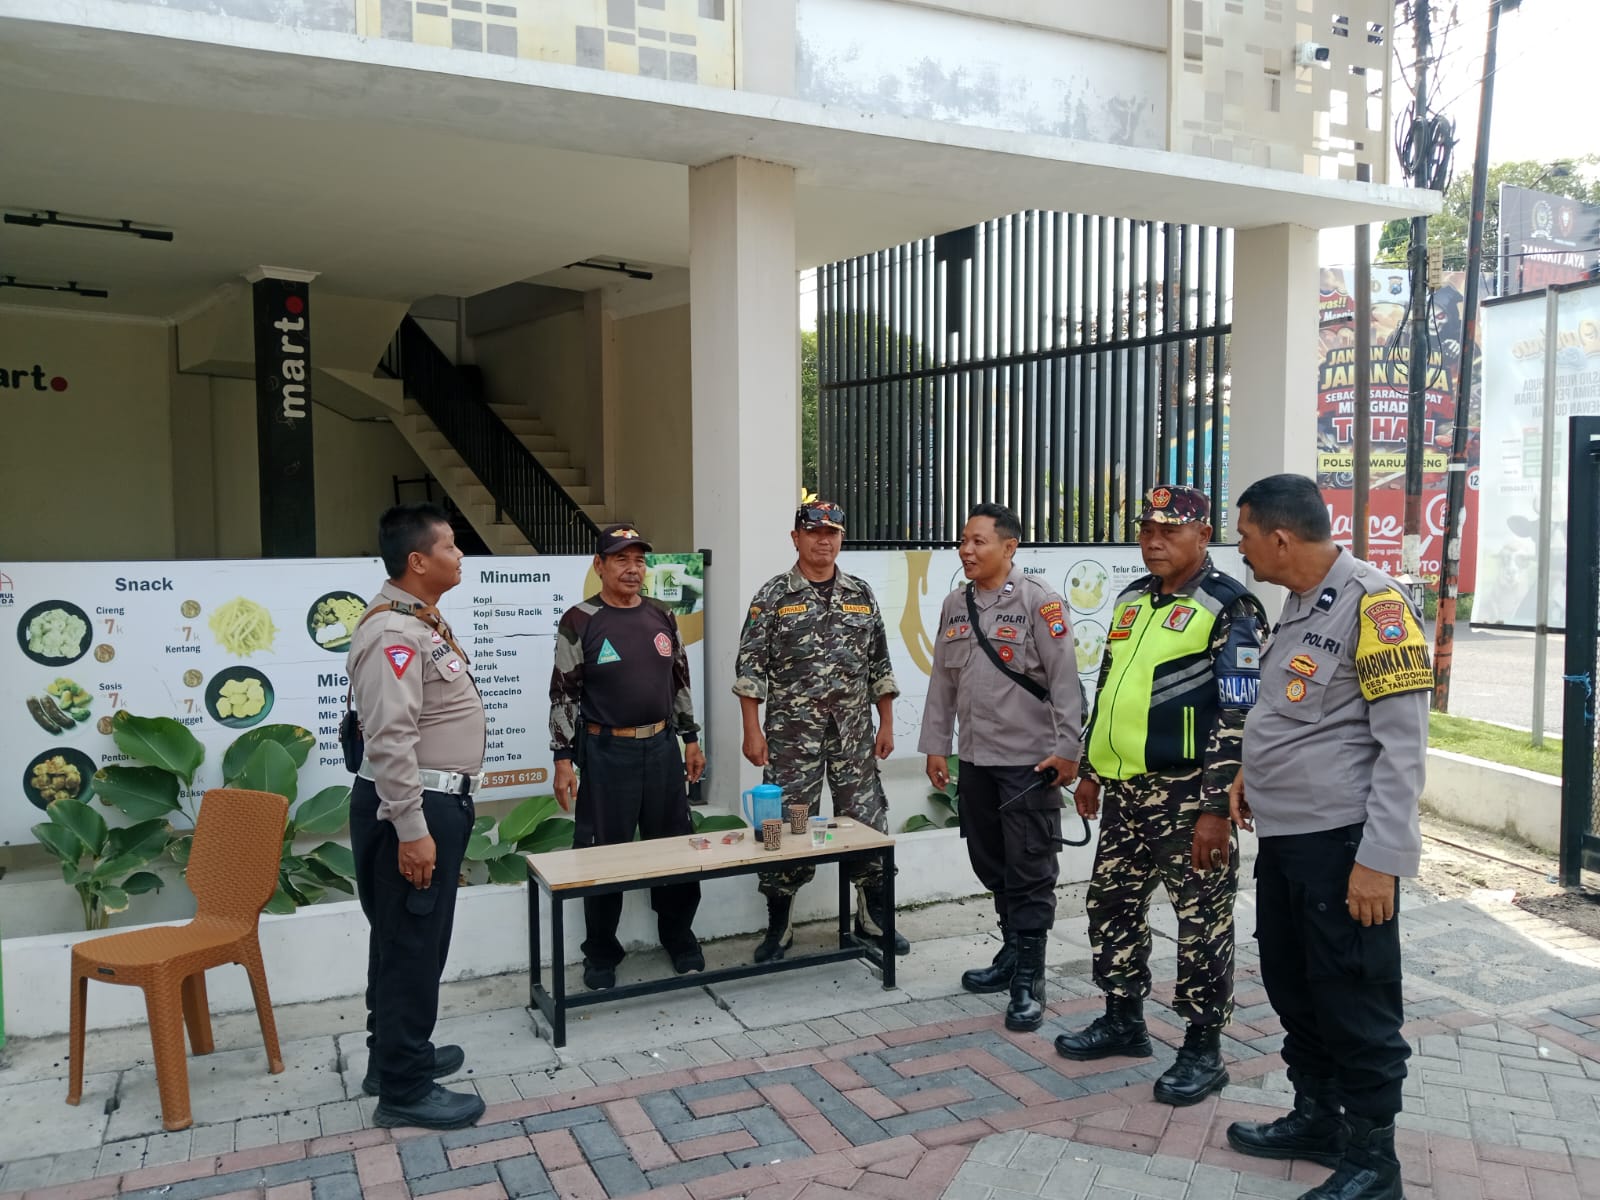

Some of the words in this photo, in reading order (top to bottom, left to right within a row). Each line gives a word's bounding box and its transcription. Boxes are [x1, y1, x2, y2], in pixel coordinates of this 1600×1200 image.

[1328, 347, 1383, 366] JANN
[1388, 347, 1442, 366] JADAN
[274, 317, 306, 418] mart
[1321, 363, 1388, 390] JAN
[1393, 363, 1448, 391] RYA
[1338, 401, 1428, 414] MGHAD
[1332, 416, 1435, 445] THA
[1323, 458, 1354, 467] POLS
[1369, 458, 1442, 467] WARUJENG
[1112, 565, 1129, 573] Telur
[480, 571, 551, 583] Minuman
[115, 577, 174, 591] Snack
[473, 596, 493, 604] Kopi
[96, 607, 125, 615] Cireng
[473, 610, 493, 618] Kopi
[518, 608, 543, 616] Racik
[995, 614, 1026, 624] POLRI
[1302, 632, 1341, 654] POLRI
[165, 645, 201, 653] Kentang
[474, 663, 498, 671] Jeruk
[317, 674, 349, 687] Mie
[1366, 678, 1388, 690] DESA
[318, 696, 337, 704] Mie
[318, 711, 338, 720] Mie
[319, 726, 338, 735] Mie
[487, 728, 504, 736] klat
[320, 742, 339, 750] Mie
[487, 741, 504, 749] klat
[492, 775, 515, 784] 5971
[518, 772, 542, 781] 6128
